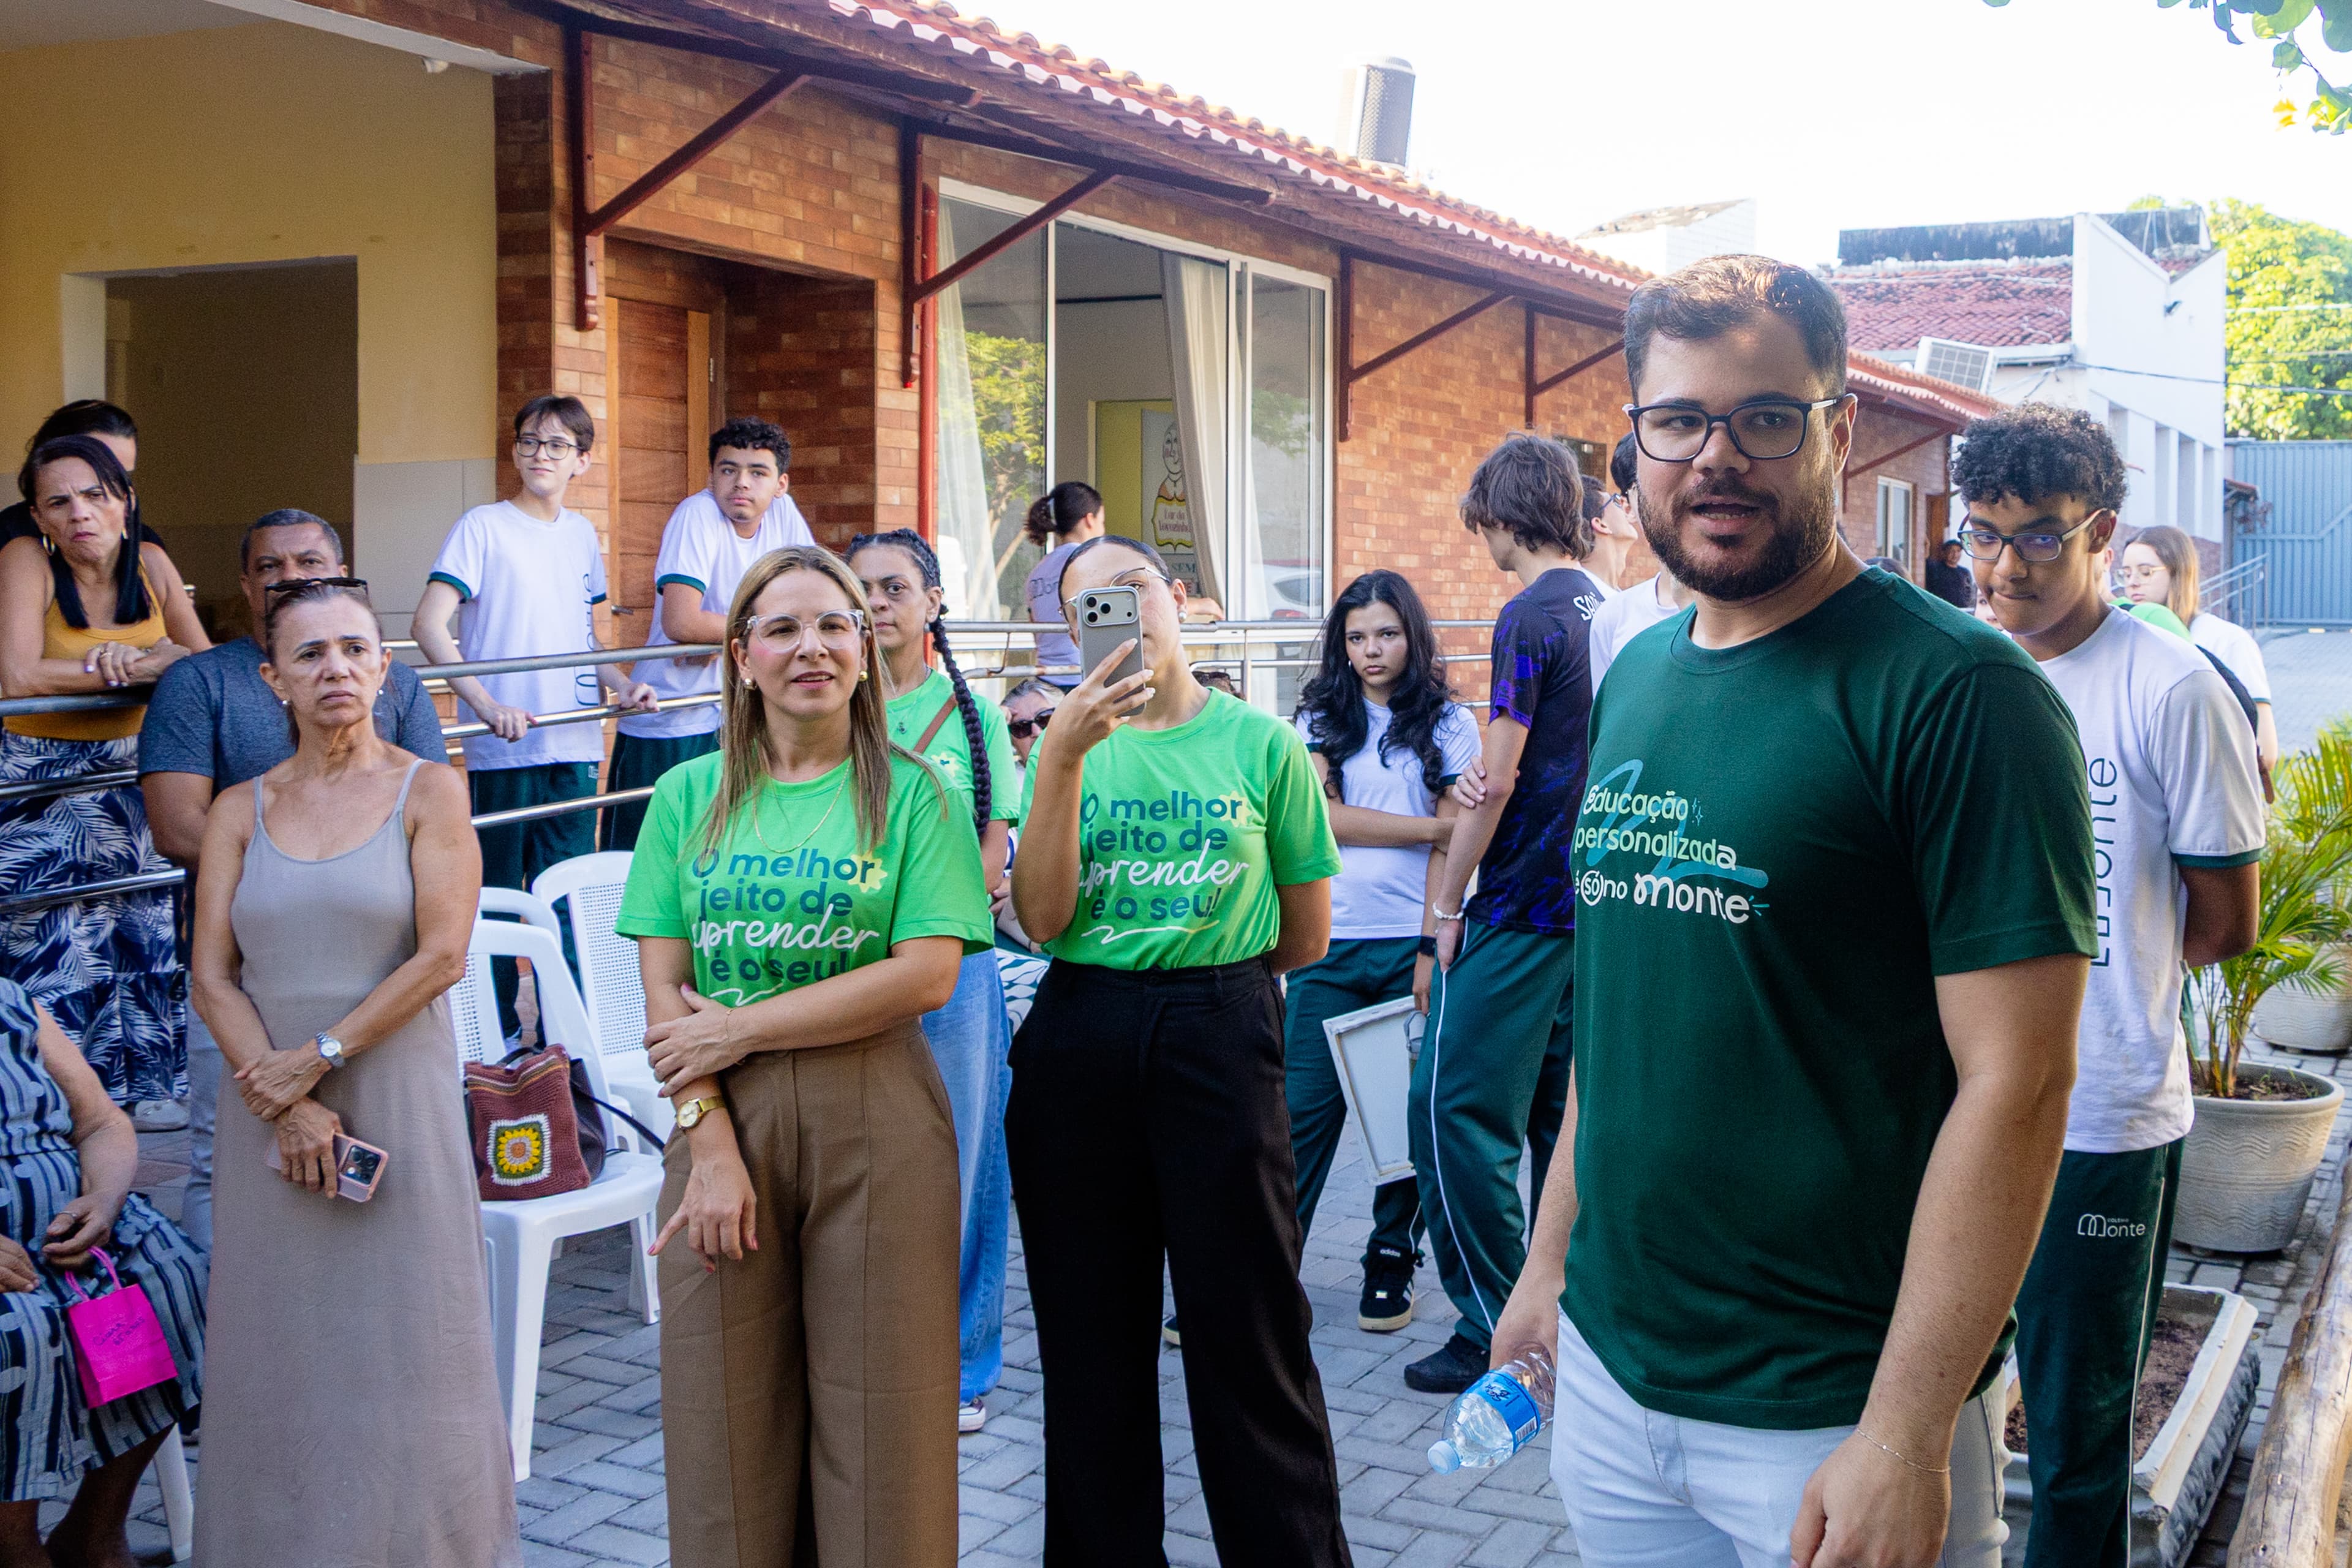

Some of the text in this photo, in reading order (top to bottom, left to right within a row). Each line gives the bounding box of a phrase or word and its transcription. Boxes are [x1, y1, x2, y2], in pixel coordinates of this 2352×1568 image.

[1080, 790, 1242, 824] O melhor
[1583, 784, 1689, 823] Educação
[1087, 820, 1229, 864] jeito de
[1574, 826, 1737, 871] personalizada
[692, 848, 875, 884] O melhor
[698, 878, 853, 922] jeito de
[1090, 887, 1222, 921] é o seu!
[1602, 879, 1628, 900] no
[710, 949, 731, 982] é
[738, 958, 761, 981] o
[2077, 1213, 2146, 1237] Monte
